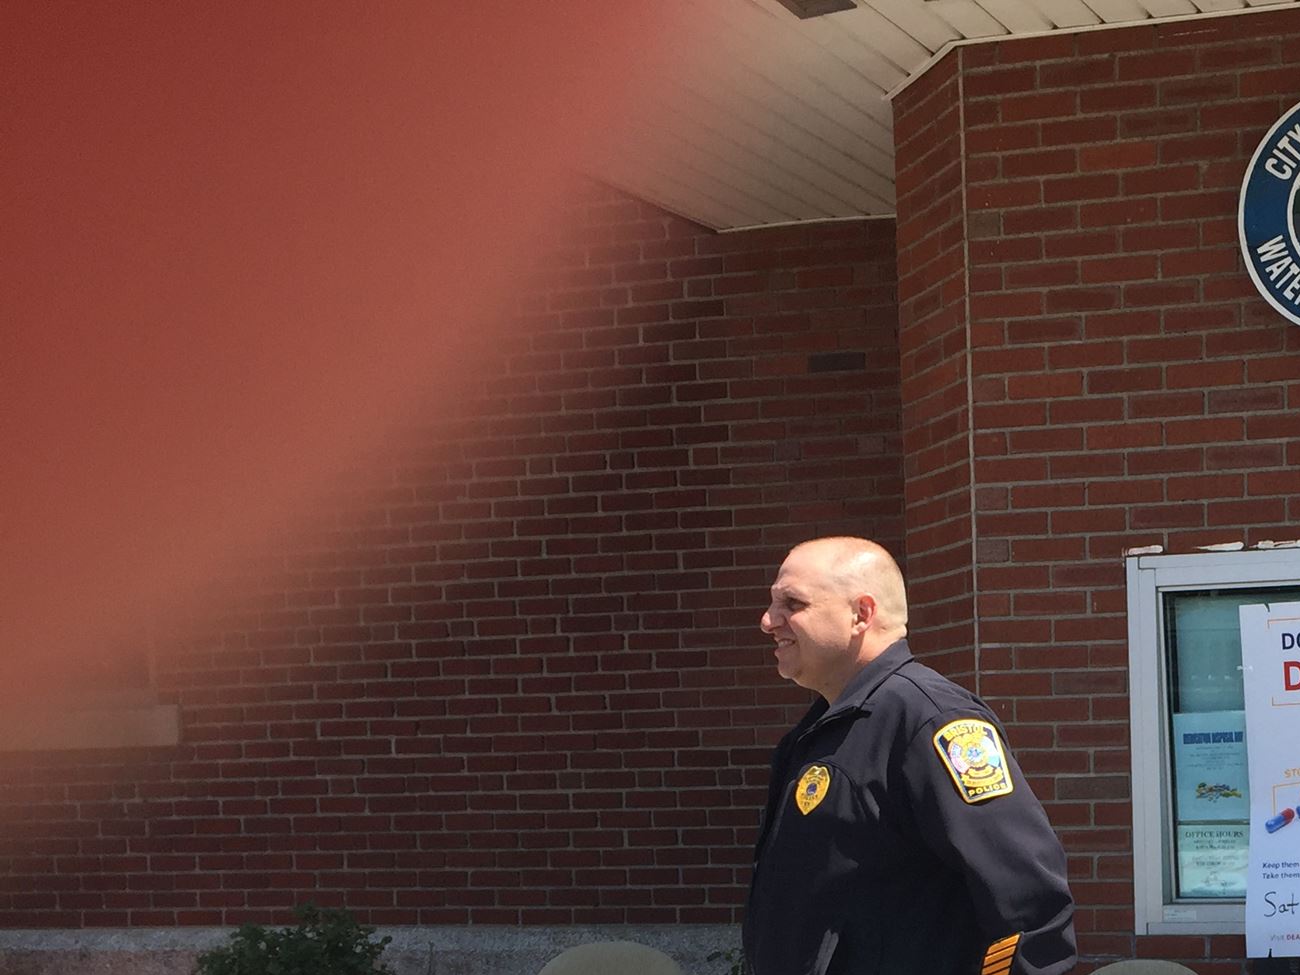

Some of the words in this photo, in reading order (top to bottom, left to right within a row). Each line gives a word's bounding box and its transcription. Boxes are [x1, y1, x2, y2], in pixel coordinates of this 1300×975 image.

[943, 724, 988, 741] BRISTOL
[968, 783, 1007, 796] POLICE
[1262, 862, 1280, 870] Keep
[1264, 892, 1300, 918] Sat
